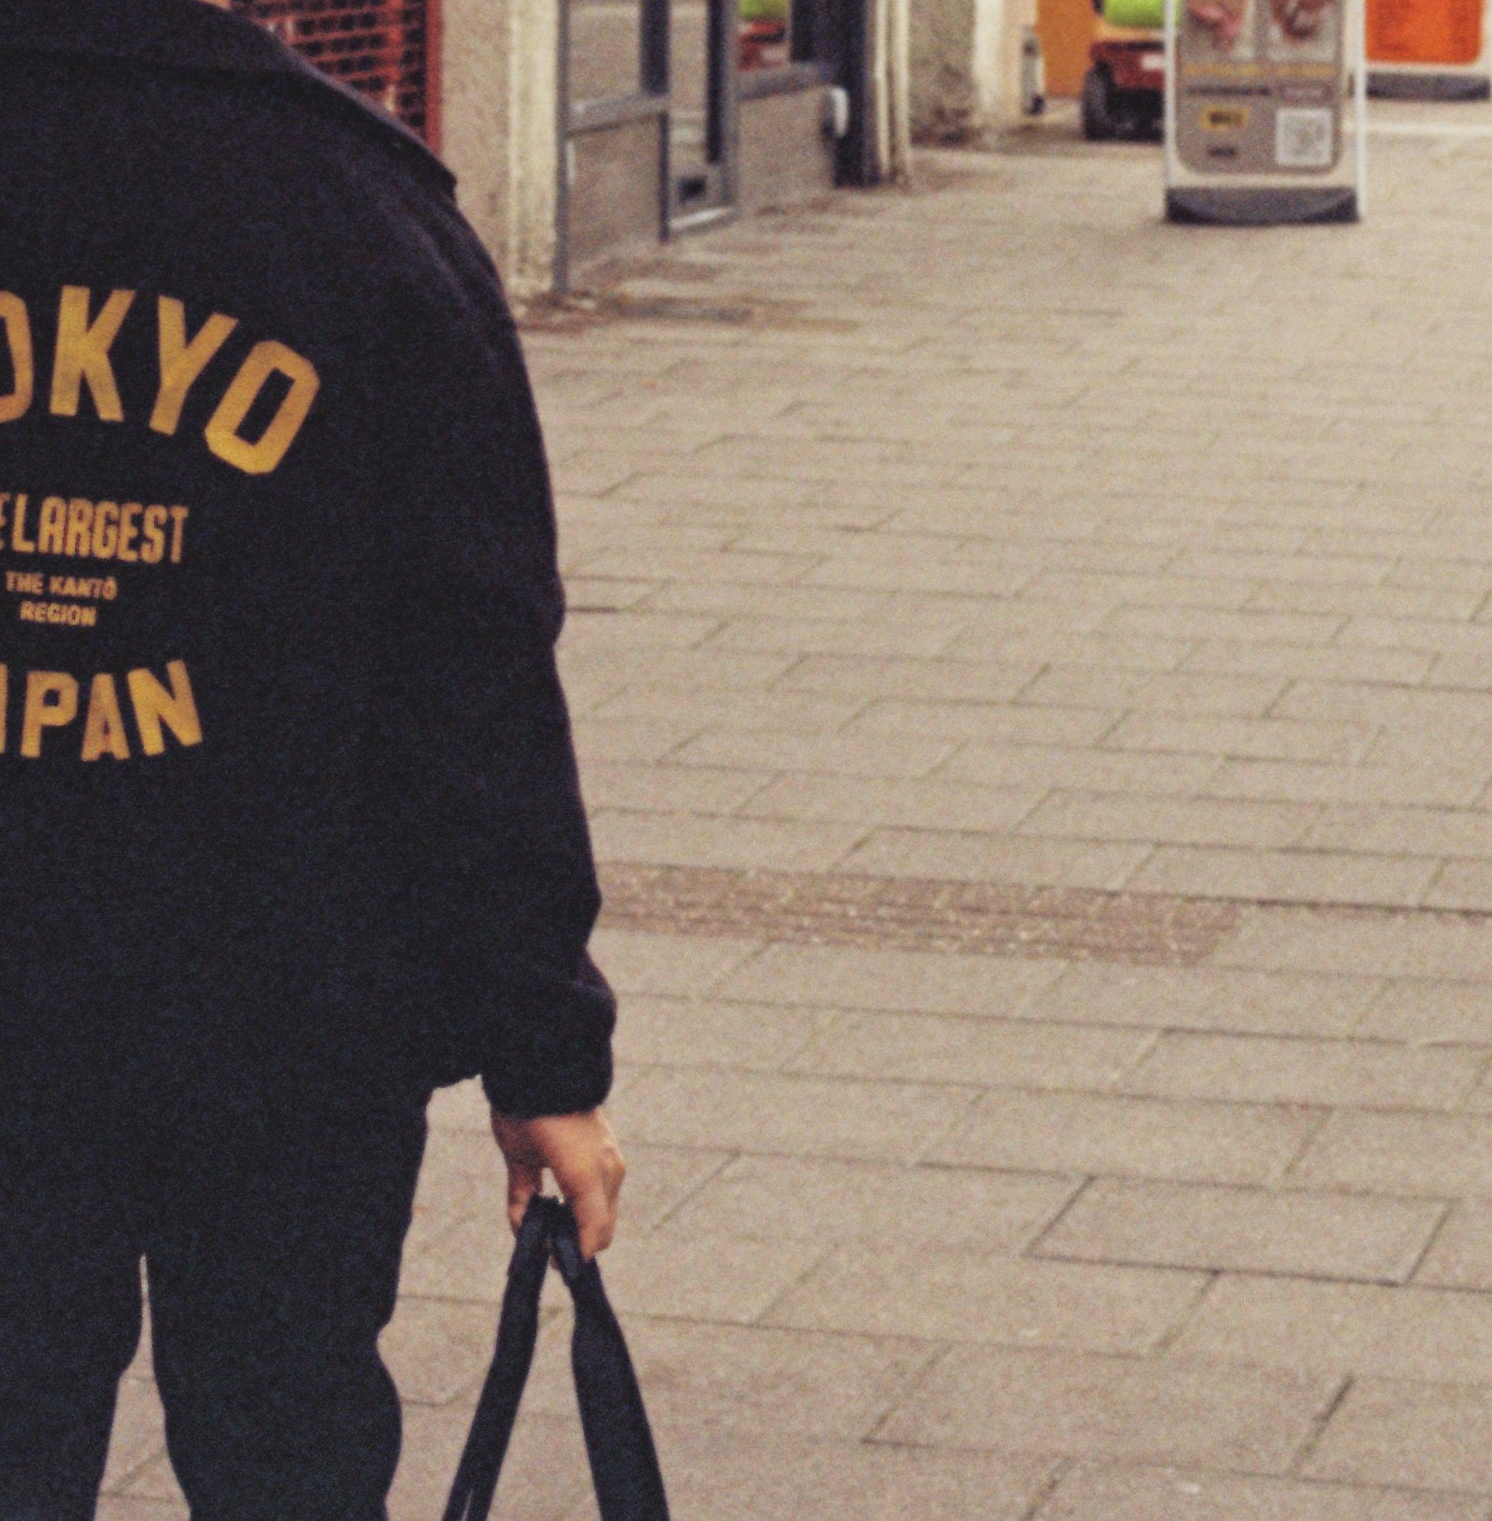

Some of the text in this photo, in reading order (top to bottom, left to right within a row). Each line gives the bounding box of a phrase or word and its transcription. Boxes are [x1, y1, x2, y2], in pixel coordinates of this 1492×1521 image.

[11, 492, 190, 564] LARGEST
[5, 570, 44, 595] THE
[19, 601, 98, 627] REGION
